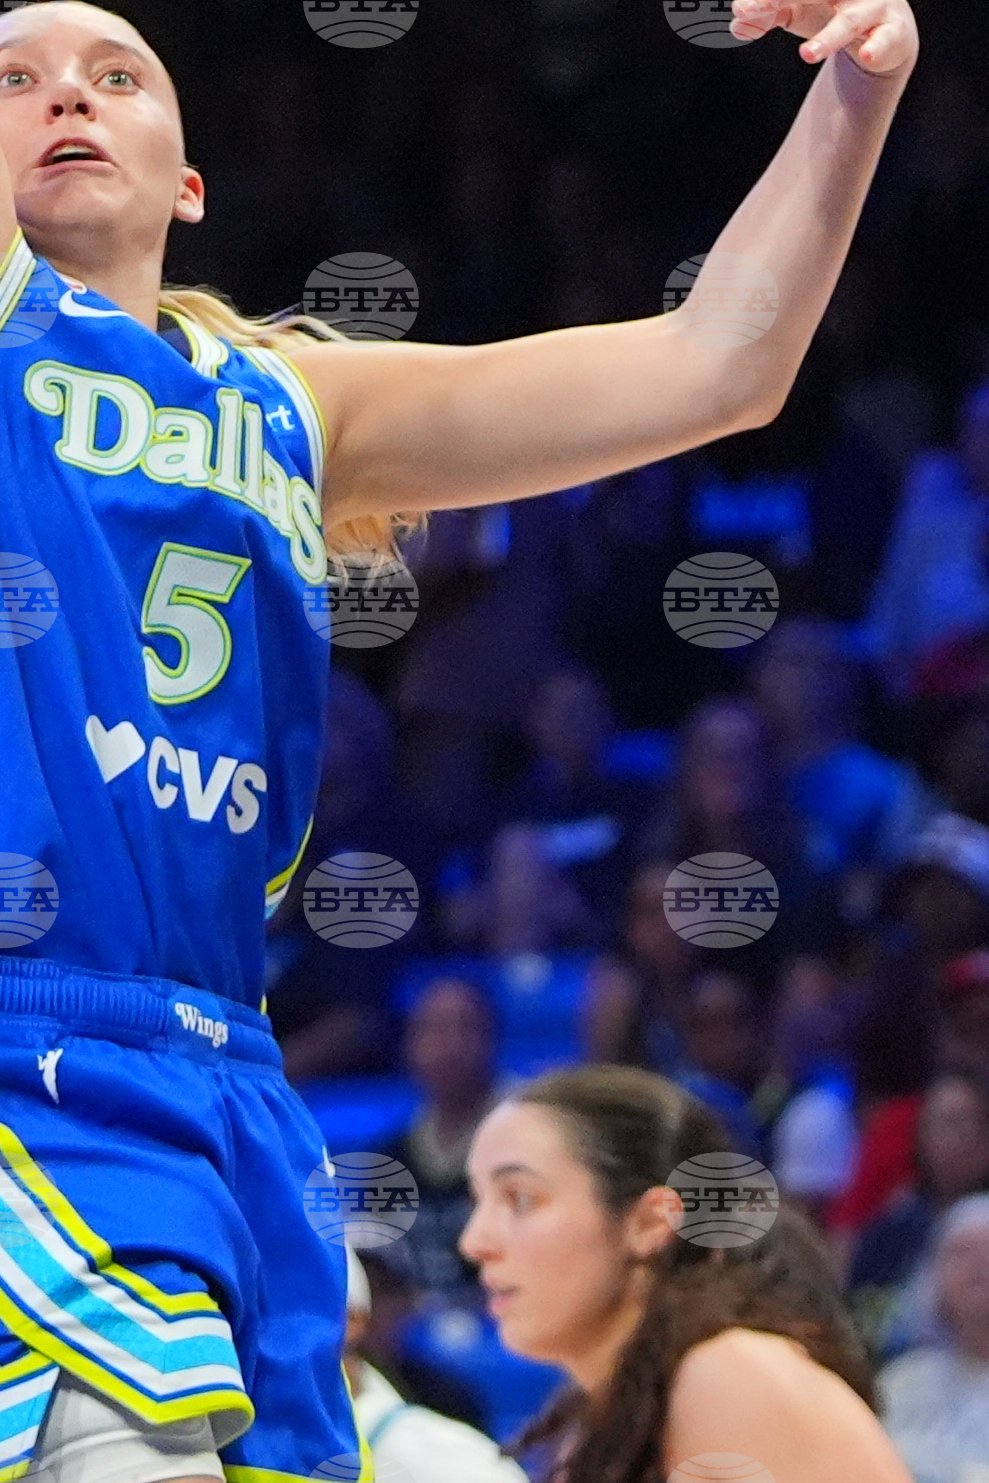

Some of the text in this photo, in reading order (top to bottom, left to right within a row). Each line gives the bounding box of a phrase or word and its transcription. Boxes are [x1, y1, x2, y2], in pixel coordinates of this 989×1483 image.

[23, 359, 327, 585] Dallas
[141, 541, 252, 705] 5
[147, 735, 268, 834] CVS
[174, 1001, 229, 1049] Wings
